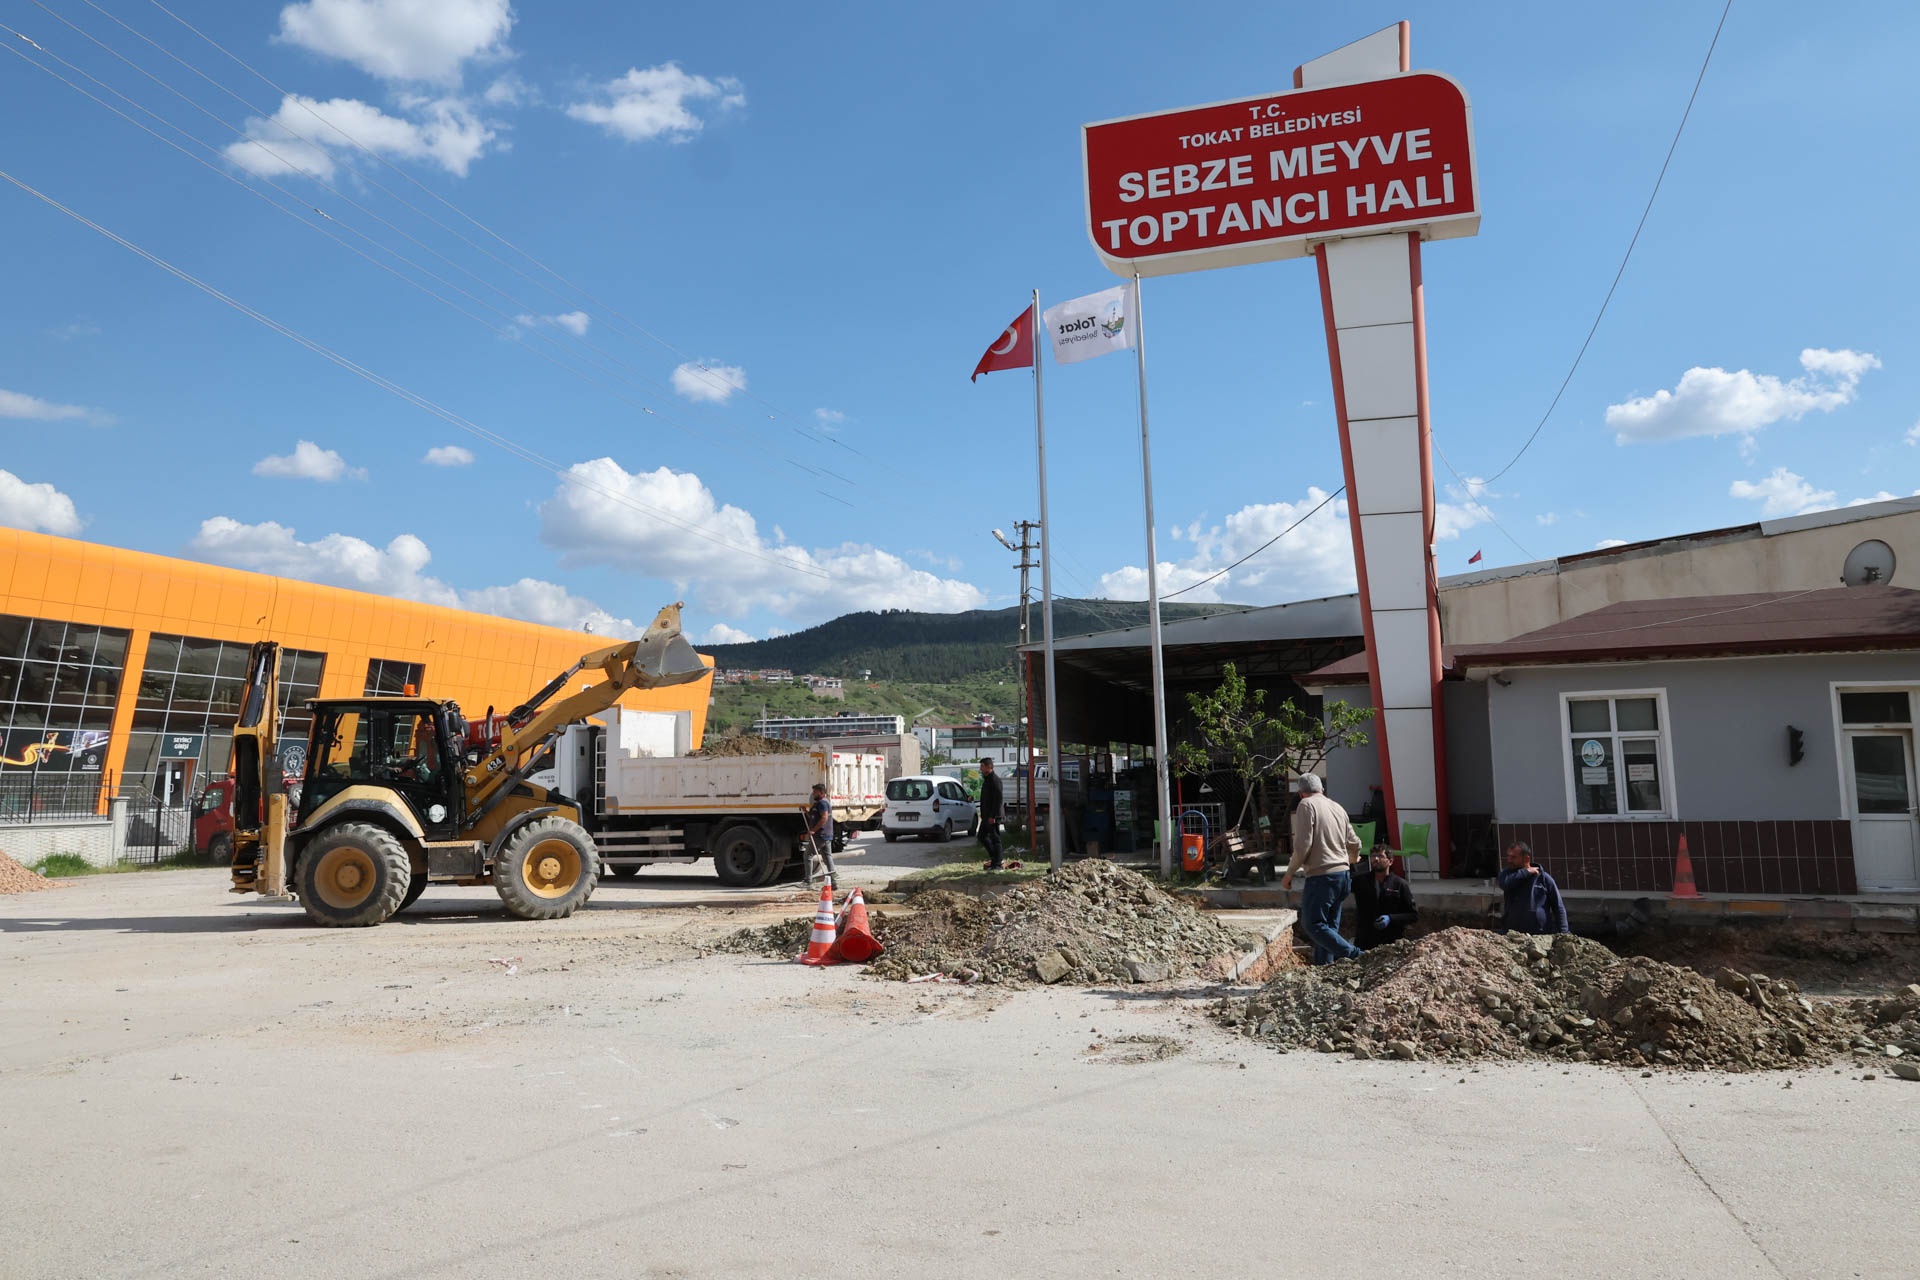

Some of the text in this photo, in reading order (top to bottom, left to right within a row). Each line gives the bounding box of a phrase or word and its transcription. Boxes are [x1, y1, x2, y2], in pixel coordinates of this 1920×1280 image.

[1179, 105, 1362, 149] TOKAT BELEDİYESİ
[1249, 103, 1286, 120] T.C.
[1118, 128, 1433, 203] SEBZE MEYVE
[1102, 163, 1455, 249] TOPTANCI HALİ
